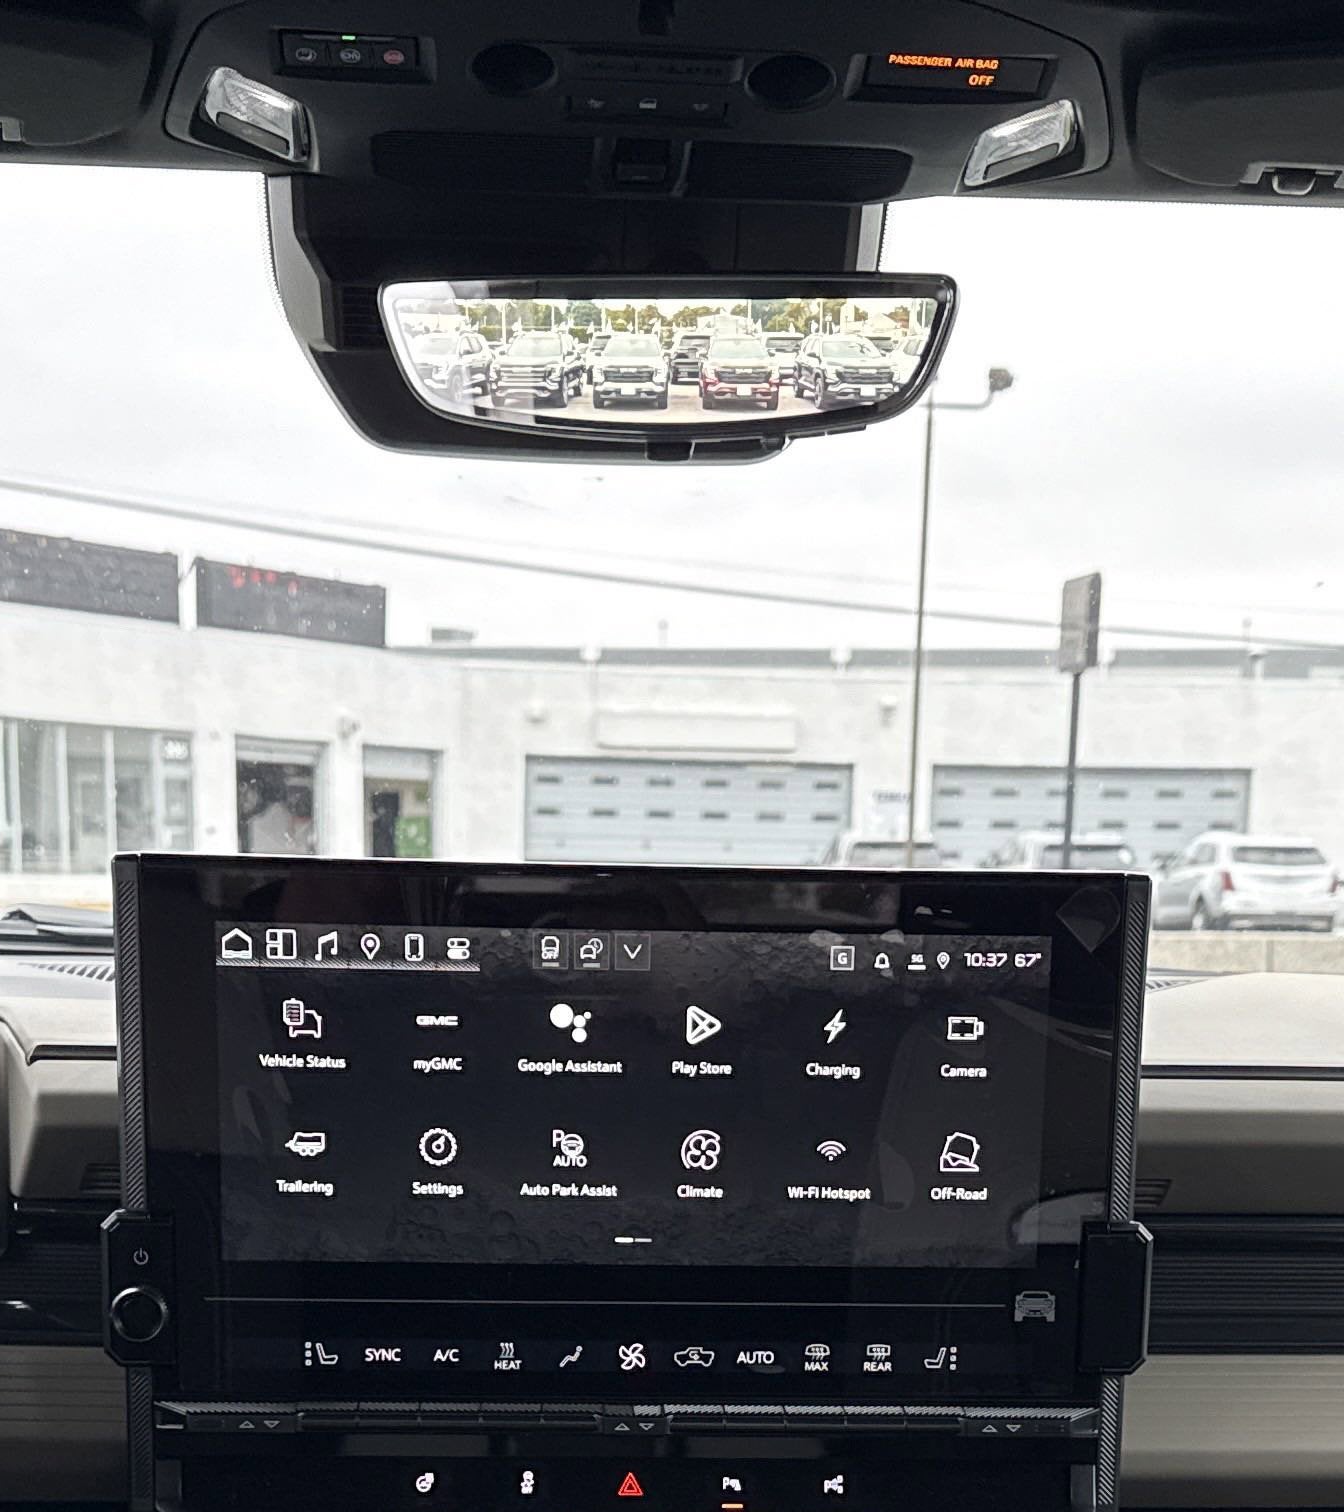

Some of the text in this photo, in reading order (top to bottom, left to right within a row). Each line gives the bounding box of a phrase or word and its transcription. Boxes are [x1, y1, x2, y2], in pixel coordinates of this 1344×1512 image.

[889, 55, 998, 69] PASSENGER AIR BAG
[969, 74, 994, 86] OFF
[964, 953, 1041, 968] 10:37 67°
[416, 1013, 459, 1028] GMC
[258, 1053, 347, 1069] Vehicle Status
[413, 1056, 463, 1073] myGMC
[517, 1058, 623, 1076] Google Assistant
[671, 1060, 733, 1078] Play Store
[805, 1062, 861, 1080] Charging
[940, 1063, 988, 1078] Camera
[553, 1155, 587, 1167] AUTO
[275, 1179, 334, 1197] Trailering
[412, 1181, 464, 1198] Settings
[519, 1182, 618, 1197] Auto Park Assist
[676, 1184, 724, 1199] Climate
[787, 1185, 871, 1202] Wi-Fi Hotspot
[930, 1186, 988, 1201] Off-Road
[365, 1347, 402, 1362] SYNC
[433, 1348, 460, 1362] A/C
[736, 1350, 775, 1365] AUTO
[494, 1359, 522, 1370] HEAT
[804, 1361, 829, 1372] MAX
[863, 1361, 892, 1372] REAR
